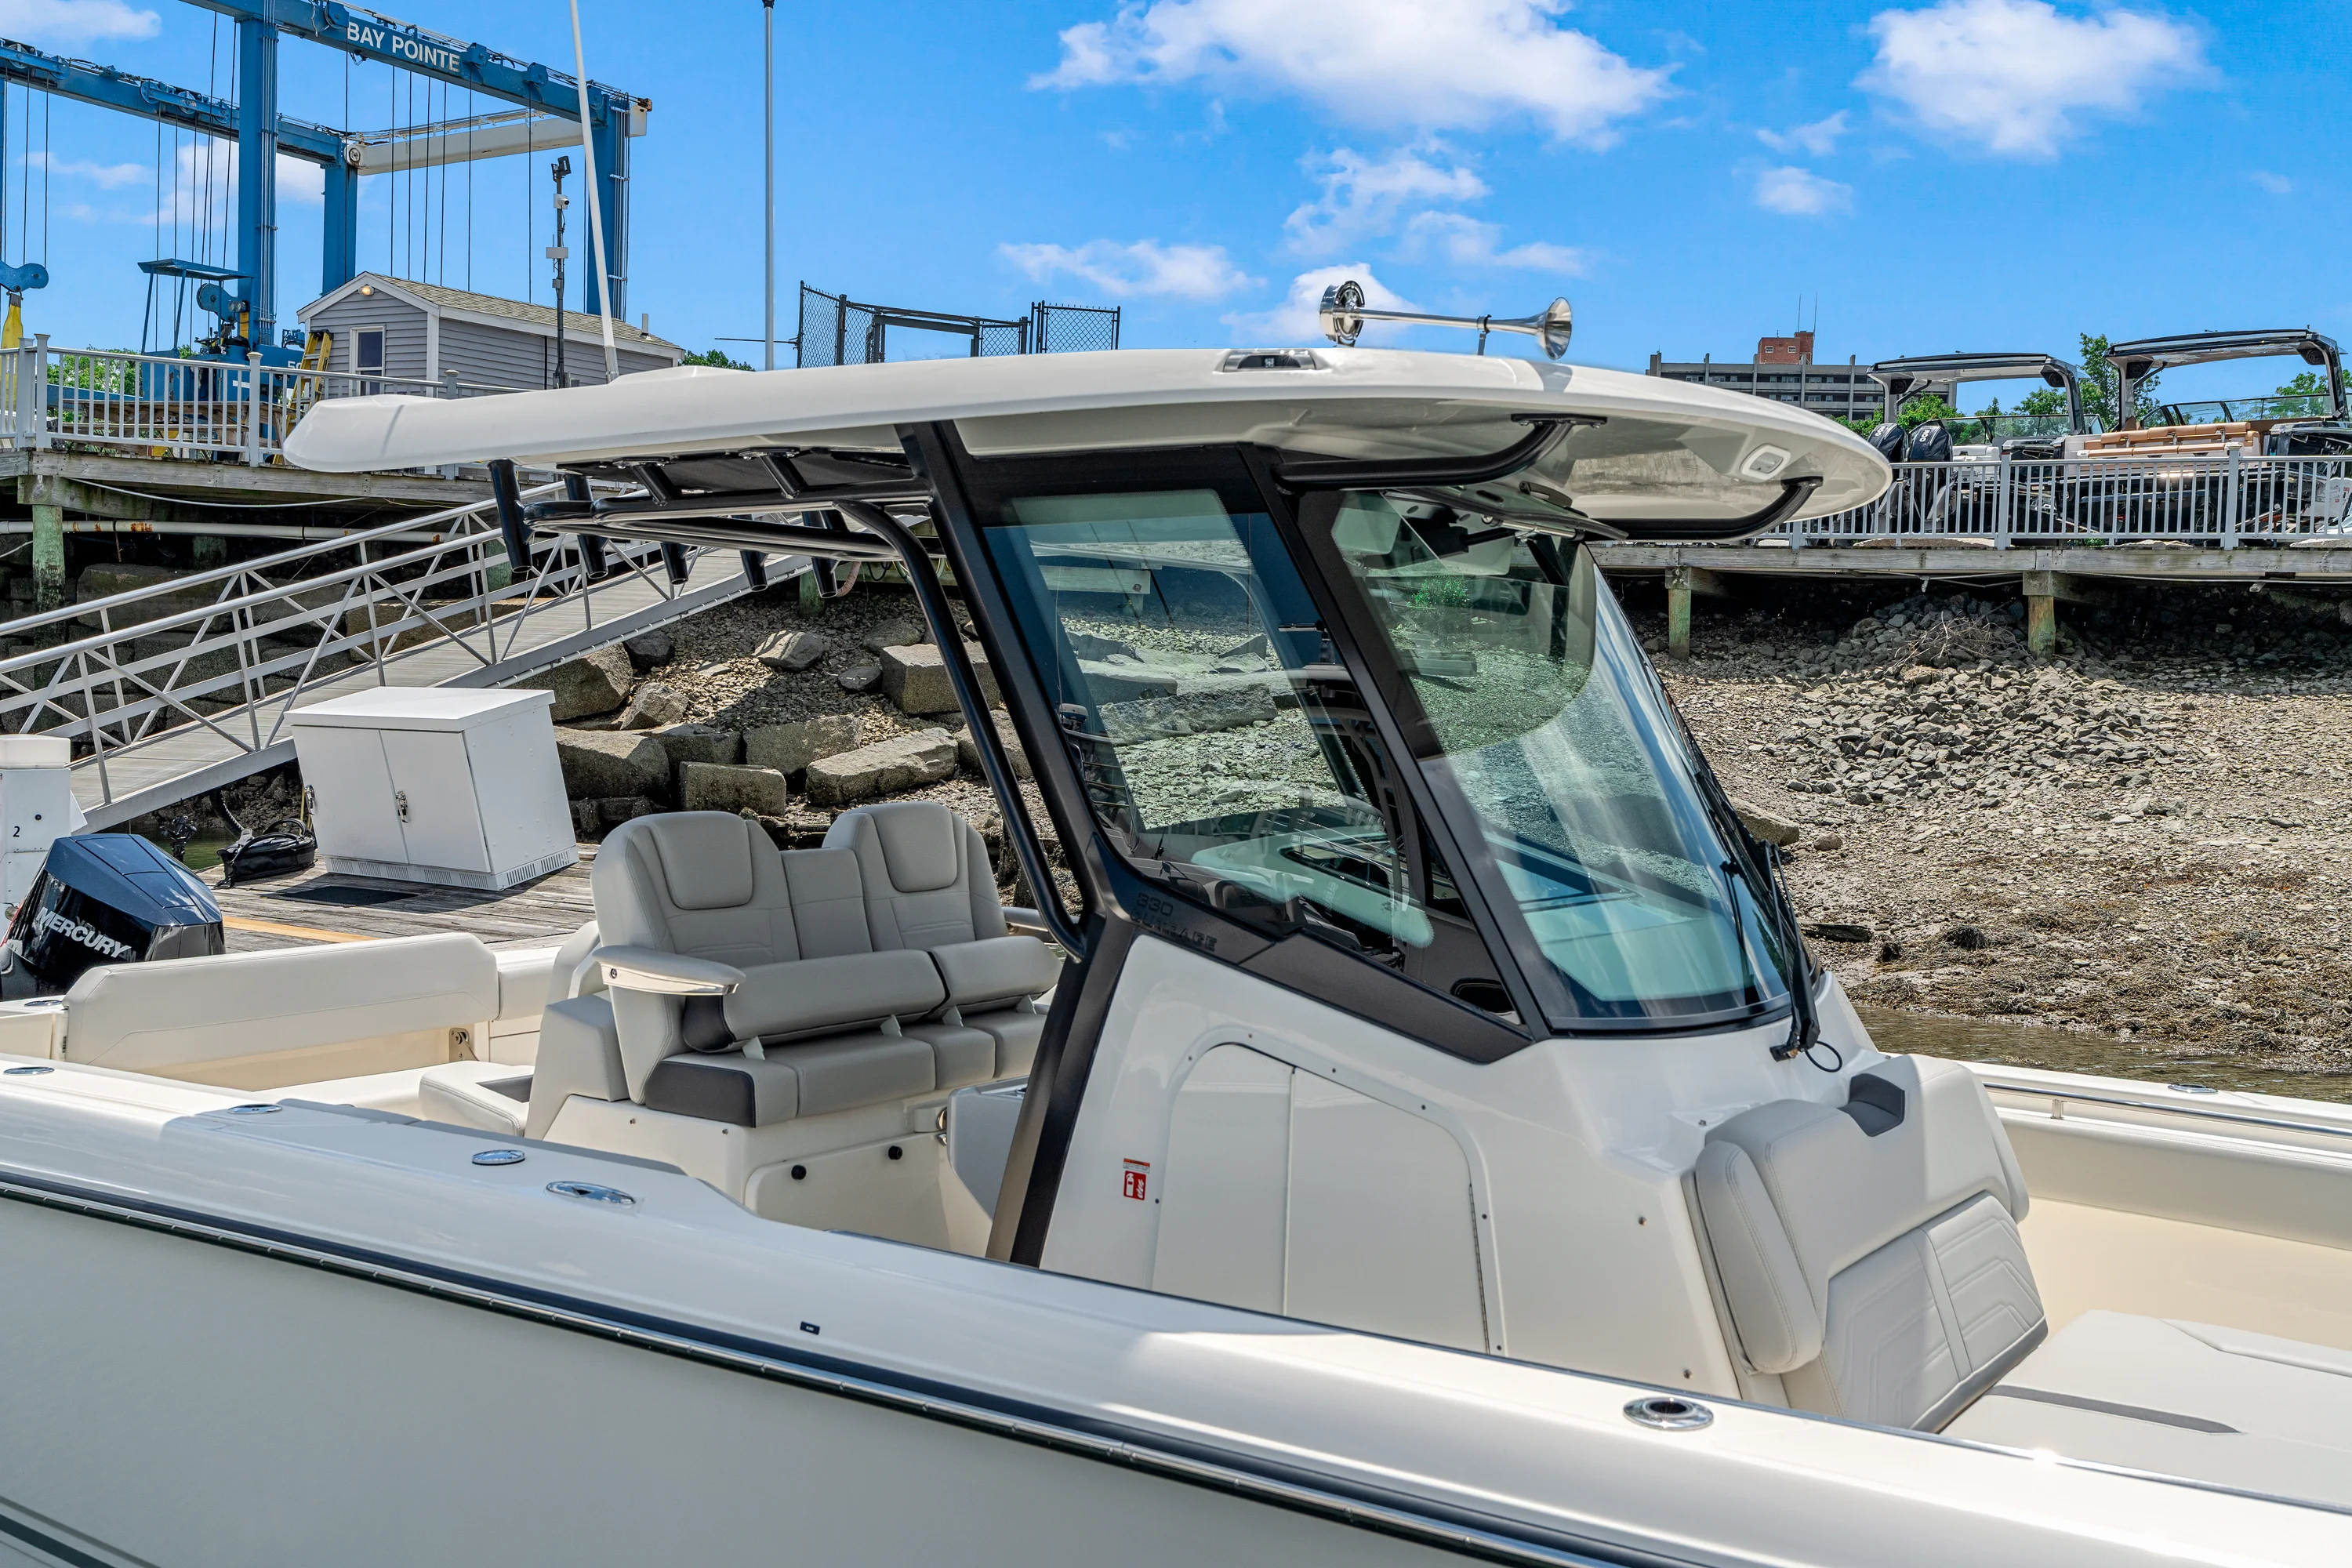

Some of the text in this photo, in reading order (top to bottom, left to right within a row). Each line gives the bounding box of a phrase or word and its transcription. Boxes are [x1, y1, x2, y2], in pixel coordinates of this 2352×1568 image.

[347, 23, 460, 72] BAY POINTE
[13, 826, 20, 837] 2
[1136, 893, 1174, 916] 330
[36, 906, 132, 958] MERCURY
